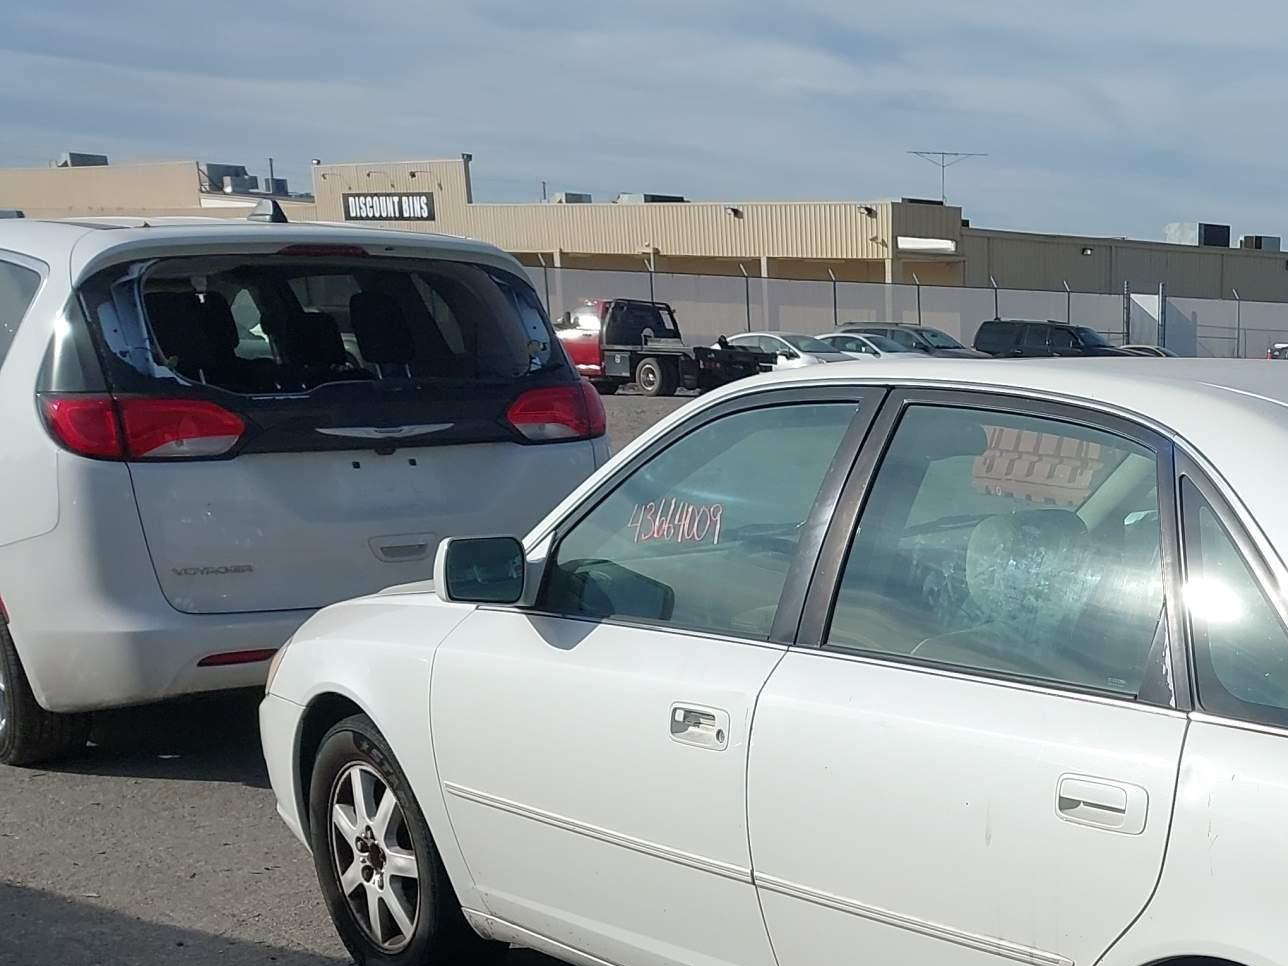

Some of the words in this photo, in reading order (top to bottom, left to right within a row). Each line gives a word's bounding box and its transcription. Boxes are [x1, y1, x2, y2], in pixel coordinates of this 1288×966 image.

[348, 196, 400, 218] DISCOUNT
[401, 195, 429, 218] BINS
[627, 497, 723, 545] 43664009
